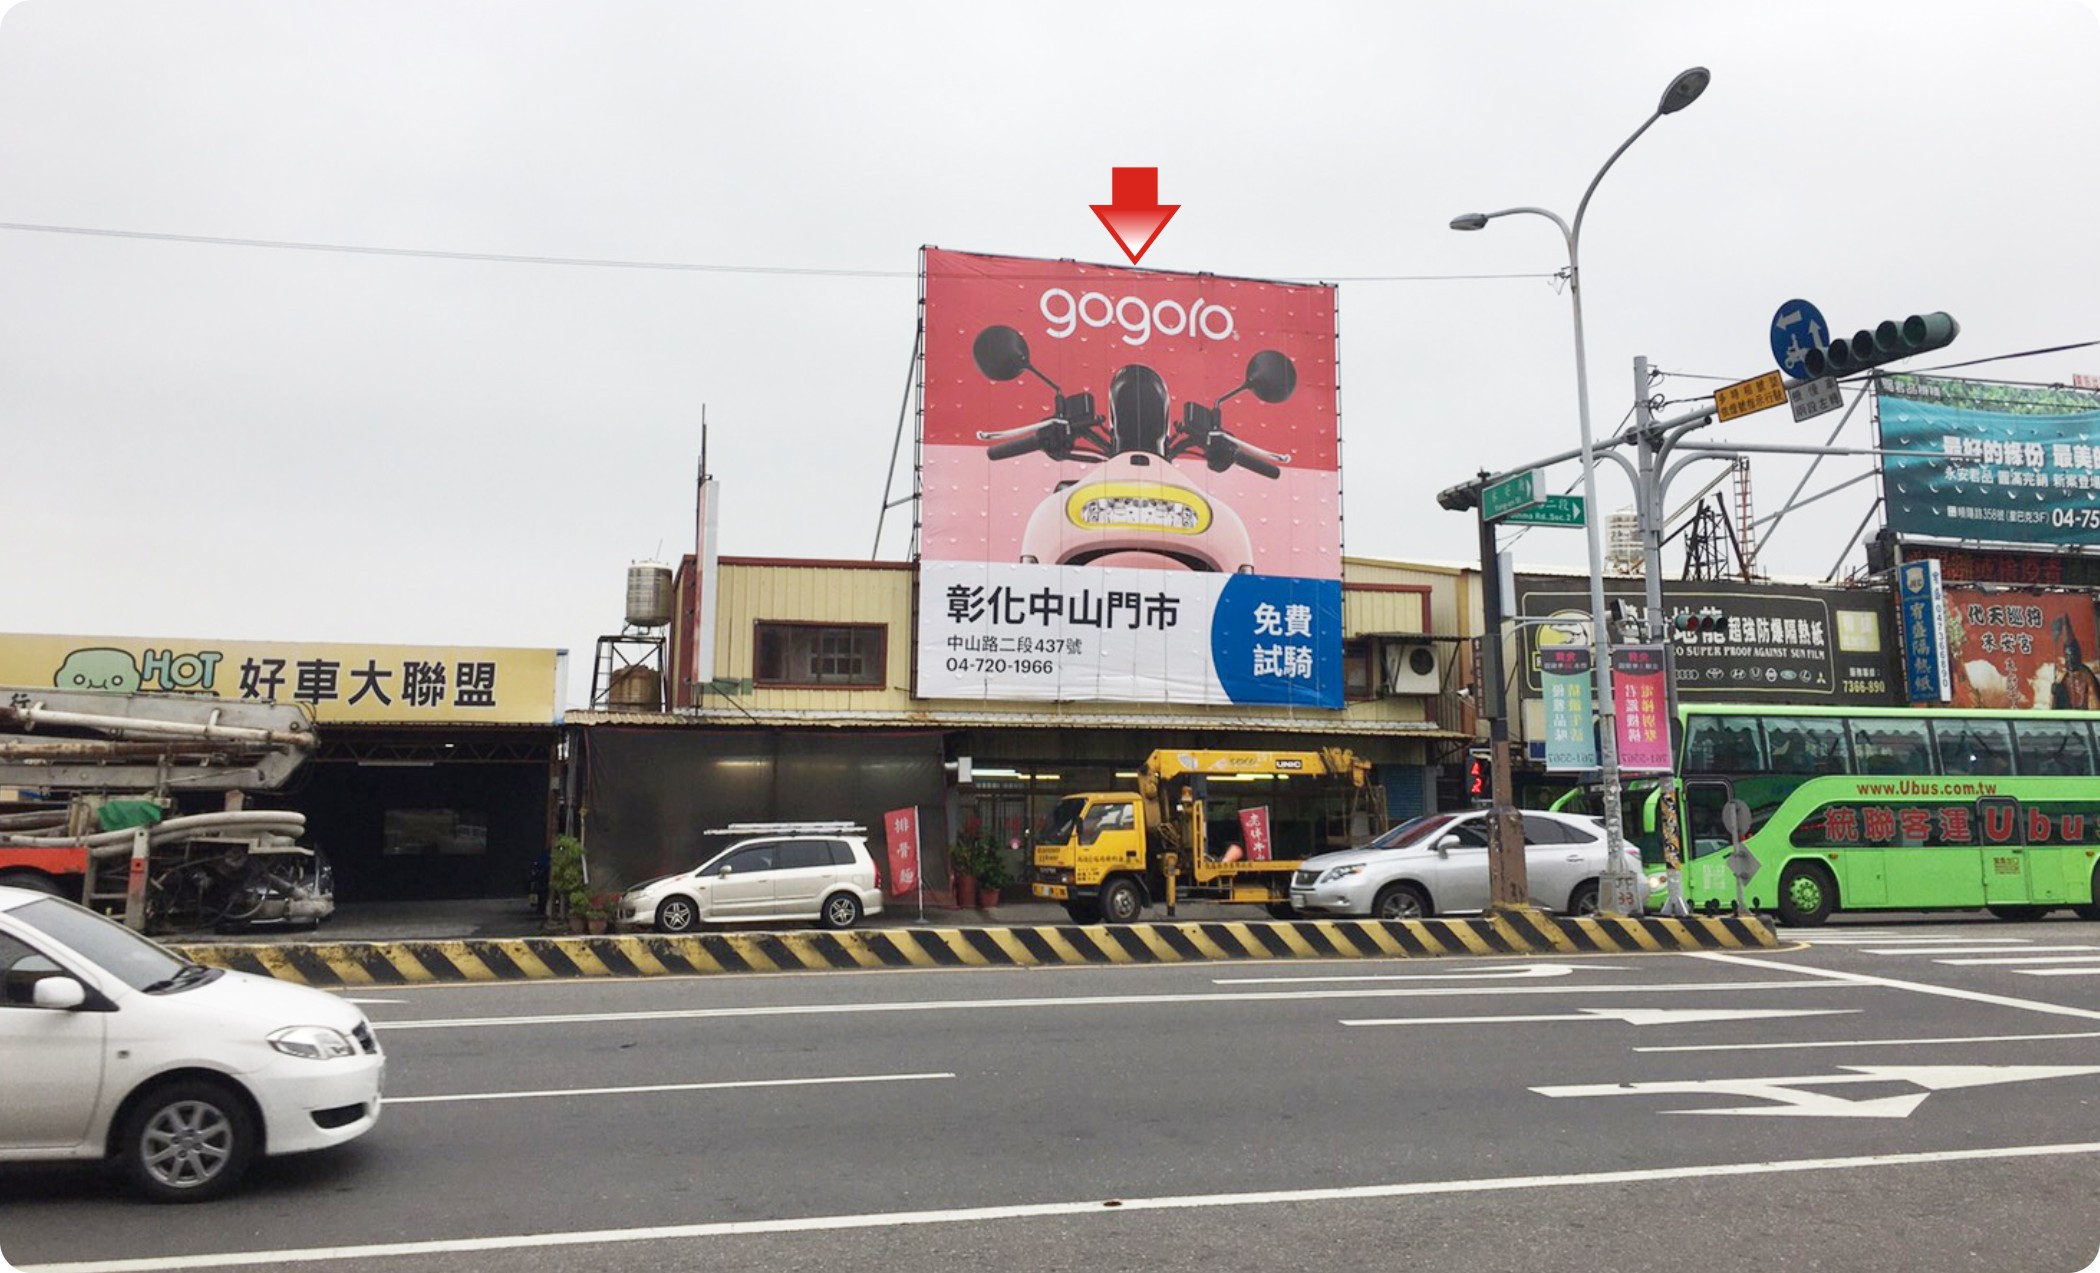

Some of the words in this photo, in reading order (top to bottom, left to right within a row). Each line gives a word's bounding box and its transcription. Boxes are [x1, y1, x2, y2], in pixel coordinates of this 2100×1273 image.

[1039, 287, 1234, 346] gogoro
[946, 584, 1180, 631] 彰化中山門市
[1253, 602, 1313, 637] 免費
[947, 634, 1083, 655] 中山路二段437號
[1252, 643, 1313, 679] 試騎
[1686, 646, 1722, 656] SUPER
[142, 648, 224, 690] HOT
[239, 657, 496, 707] 好車大聯盟
[946, 657, 1054, 674] 04-720-1966
[1276, 760, 1302, 769] UNIC
[1856, 781, 1997, 796] www.Ubus.com.tw
[1824, 805, 1972, 842] 統聯客運
[1985, 806, 2100, 841] Ubu
